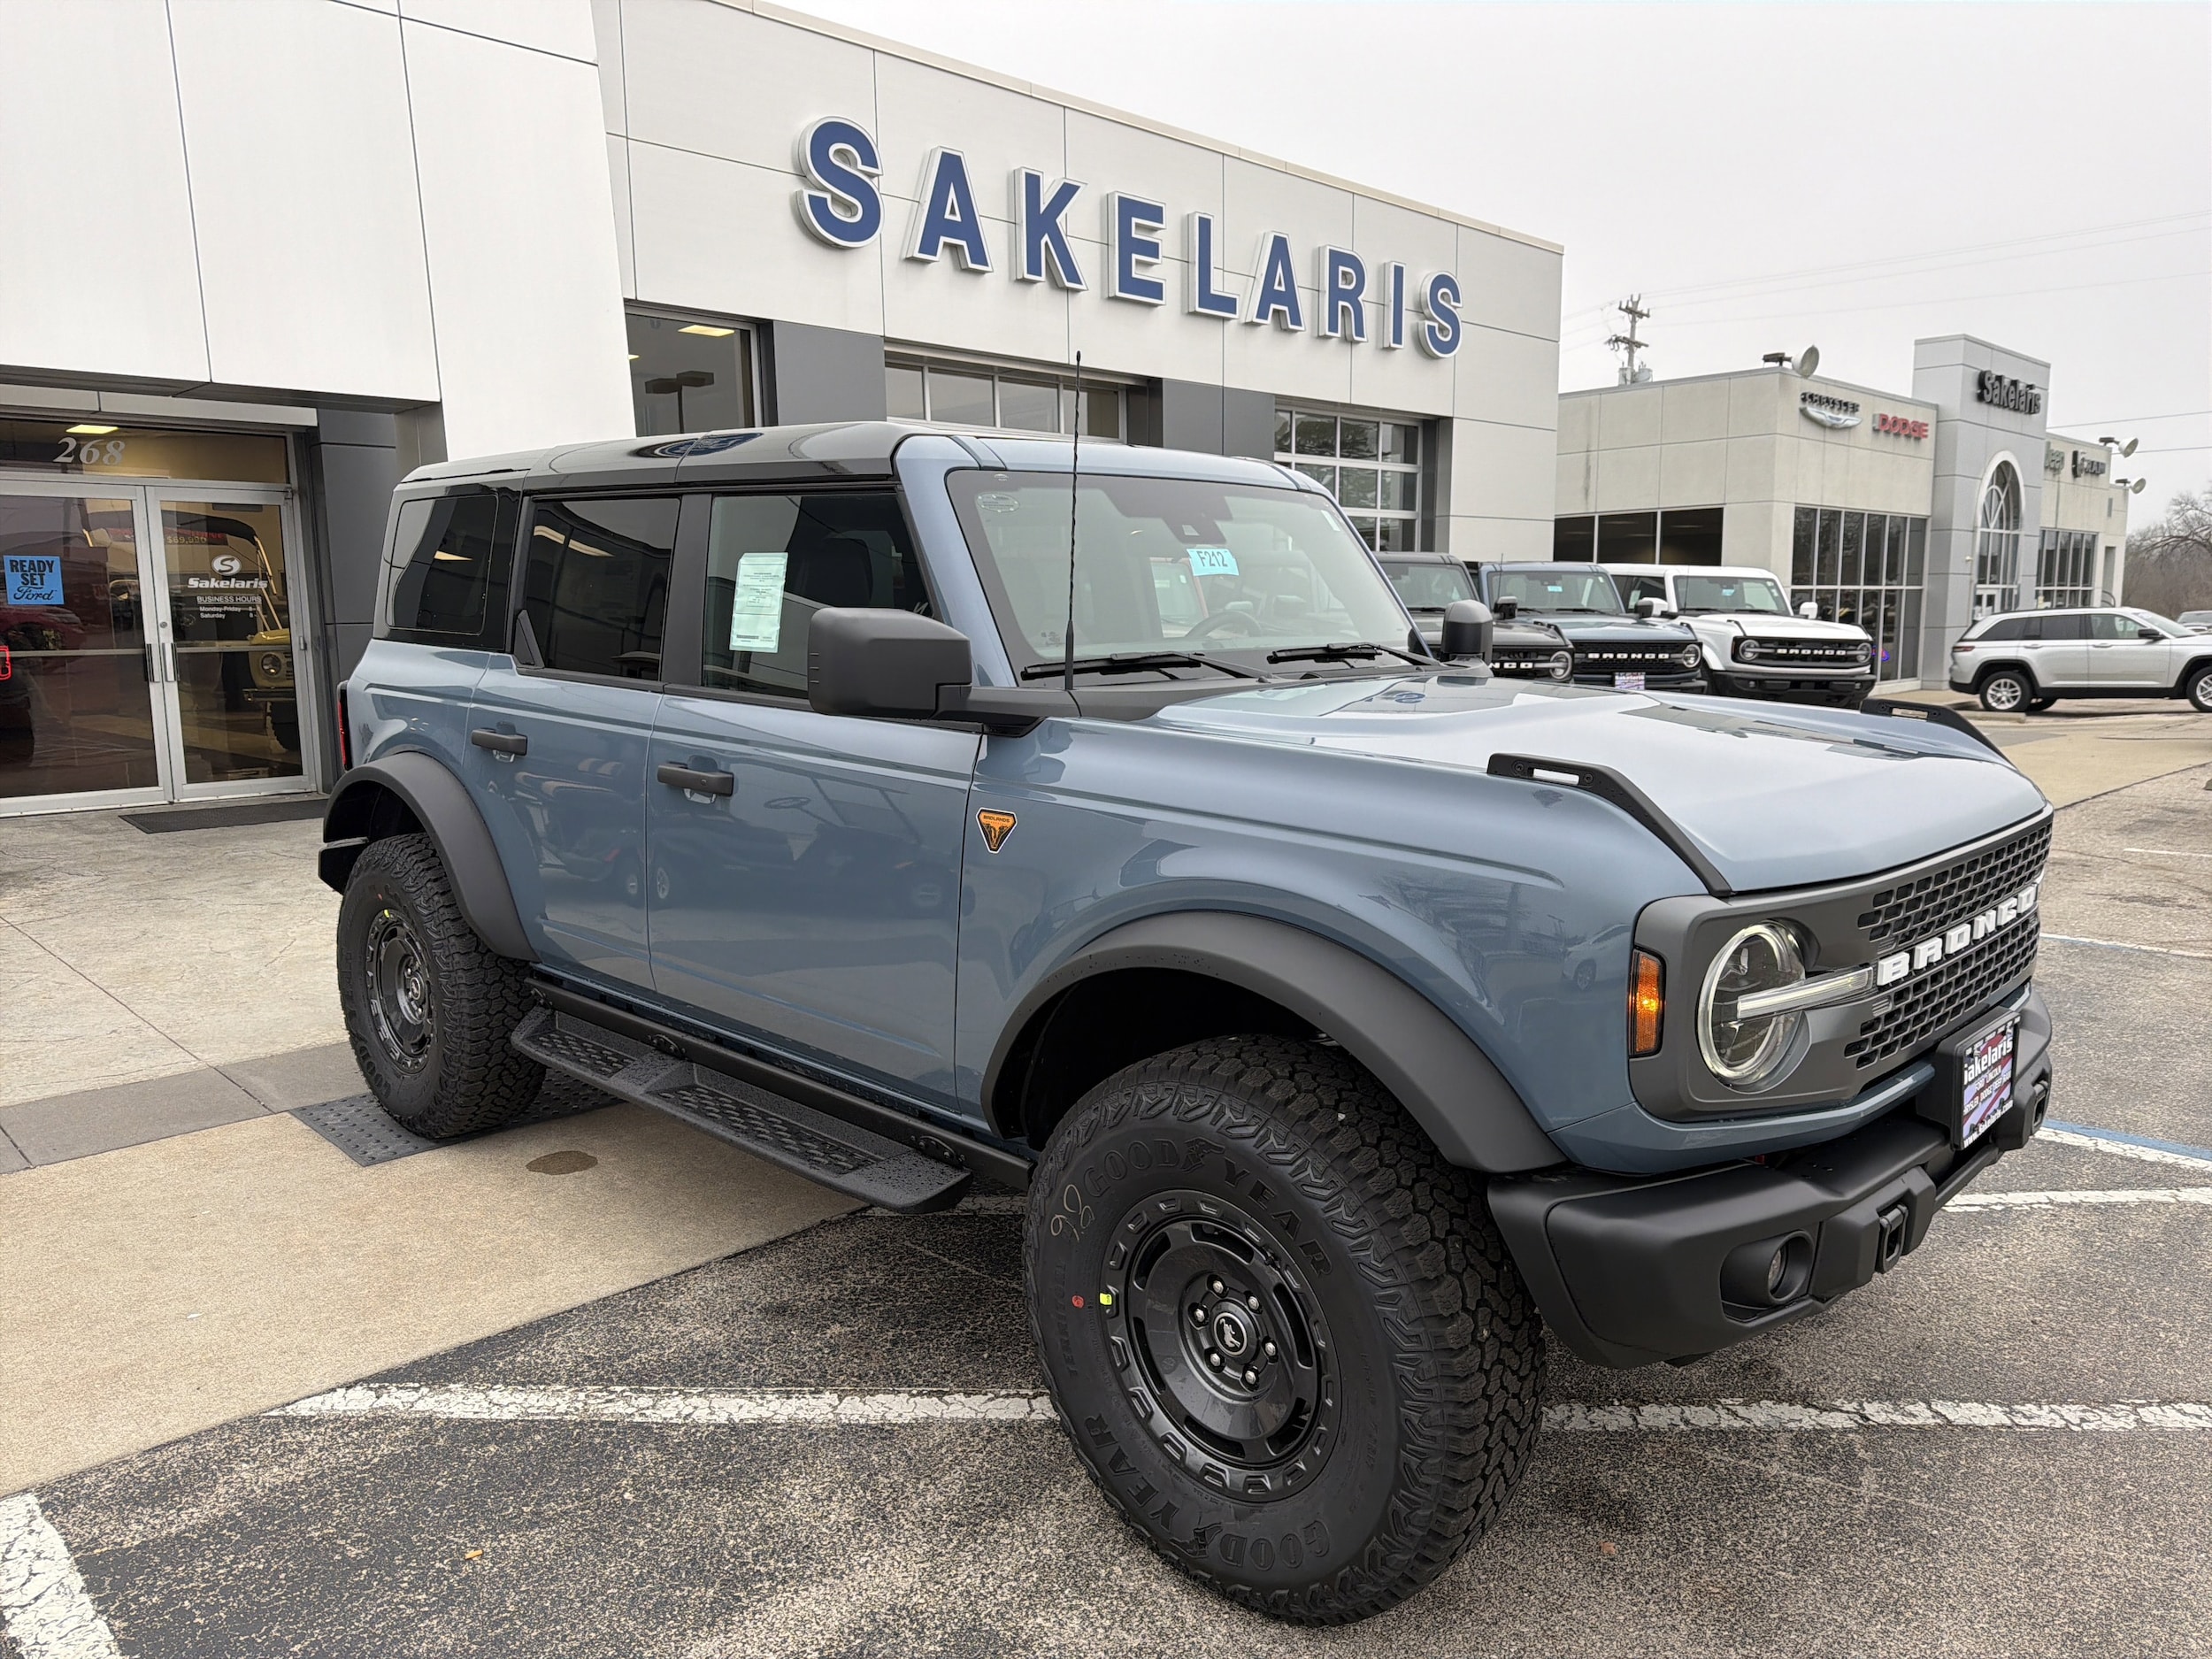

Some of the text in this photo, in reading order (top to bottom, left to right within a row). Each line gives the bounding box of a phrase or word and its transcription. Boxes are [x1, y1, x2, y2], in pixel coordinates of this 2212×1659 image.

[795, 116, 1463, 358] SAKELARIS
[1977, 370, 2042, 415] Sakelaris
[1873, 413, 1930, 440] DODGE
[53, 436, 126, 465] 268
[9, 559, 54, 573] READY
[1196, 550, 1229, 567] F212
[20, 572, 45, 586] SET
[188, 577, 268, 588] Sakelaris
[13, 586, 57, 600] Ford
[1876, 885, 2037, 987] BRONCO
